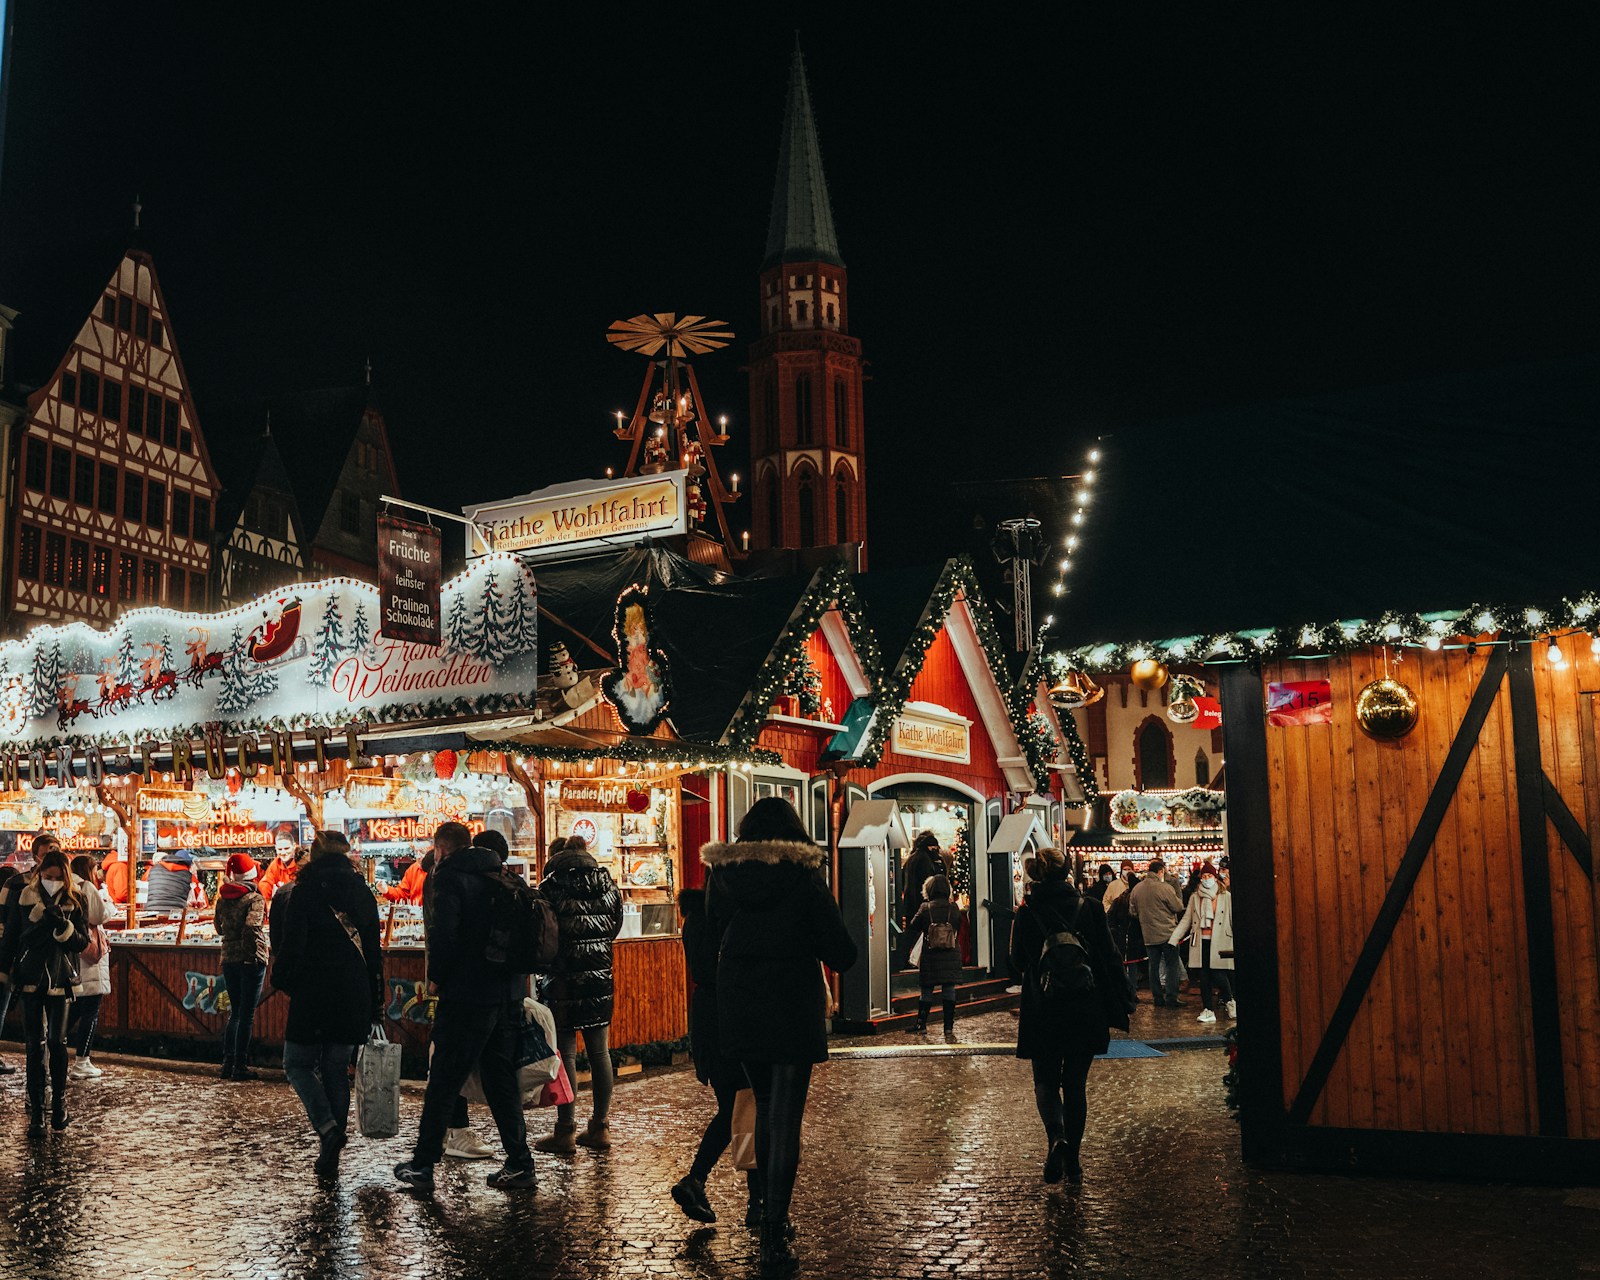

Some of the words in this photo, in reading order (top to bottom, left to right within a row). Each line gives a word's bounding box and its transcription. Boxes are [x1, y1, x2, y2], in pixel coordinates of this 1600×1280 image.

[483, 516, 544, 541] Käthe
[552, 496, 669, 532] Wohlfahrt
[497, 537, 543, 549] Rothenburg
[545, 535, 555, 543] ob
[558, 532, 571, 541] der
[574, 527, 602, 538] Tauber
[611, 521, 650, 532] Germany
[389, 540, 430, 563] Früchte
[395, 574, 425, 591] feinster
[405, 567, 413, 579] in
[391, 595, 430, 615] Pralinen
[386, 609, 434, 629] Schokolade
[332, 654, 492, 702] Weihnachten
[899, 722, 923, 742] Käthe
[926, 727, 964, 749] Wohlfahrt
[140, 793, 184, 813] Bananen
[563, 787, 597, 800] Paradies
[597, 782, 627, 808] Äpfel
[177, 829, 273, 846] Köstlichkeiten
[368, 818, 486, 840] Köstlichen
[17, 833, 99, 850] Köhkeiten
